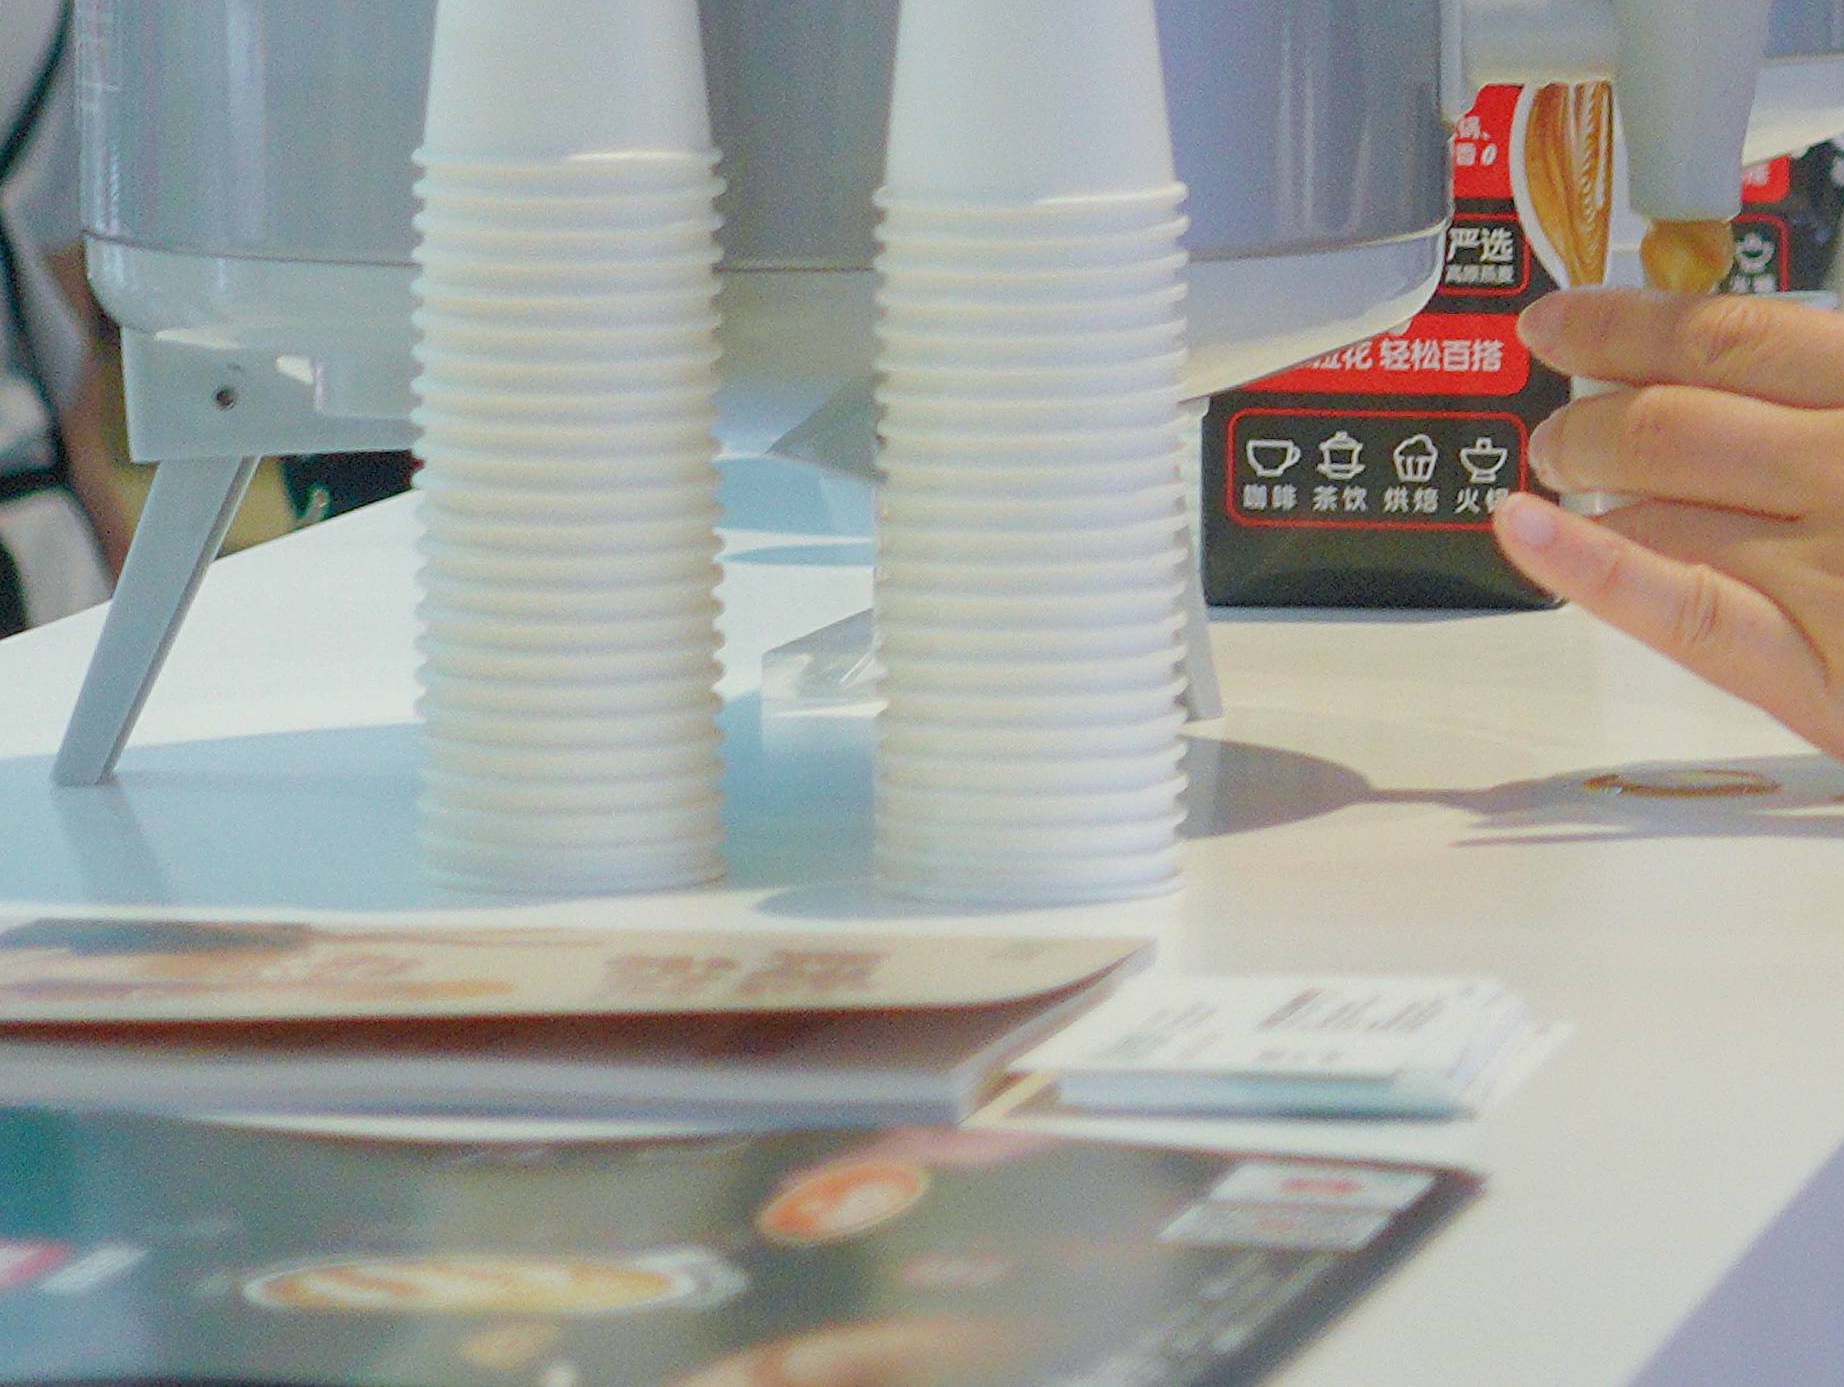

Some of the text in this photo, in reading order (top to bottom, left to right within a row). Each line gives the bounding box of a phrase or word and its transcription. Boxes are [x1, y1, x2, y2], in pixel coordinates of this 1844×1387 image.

[1446, 227, 1514, 262] 严选
[1379, 339, 1504, 372] 轻松百搭
[1243, 484, 1298, 510] 咖啡
[1313, 485, 1368, 512] 茶饮
[1384, 486, 1440, 514] 烘焙
